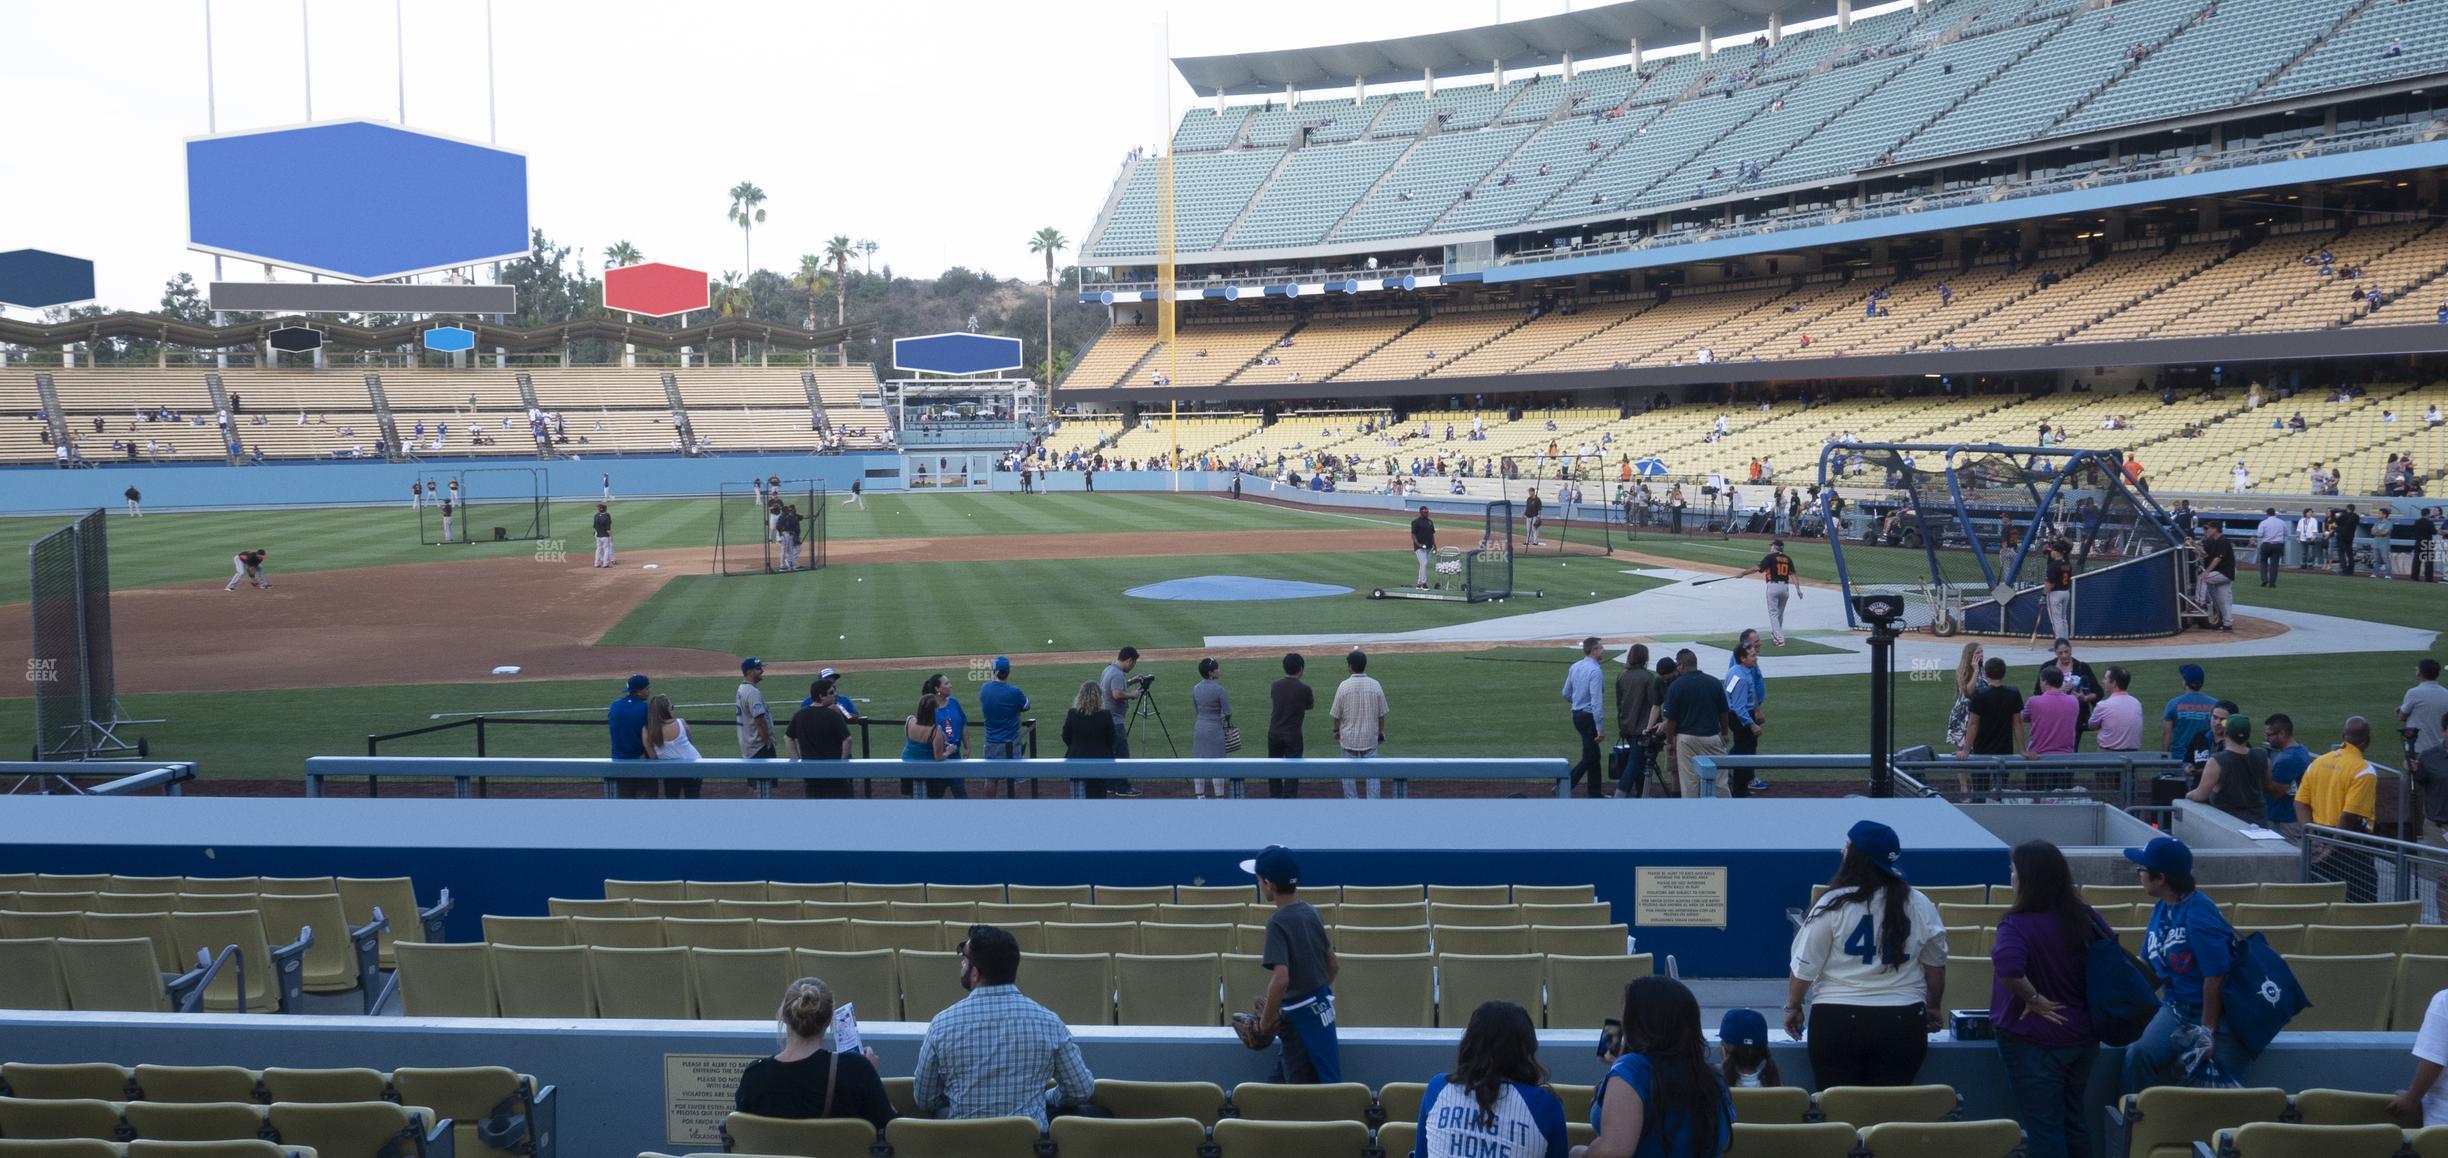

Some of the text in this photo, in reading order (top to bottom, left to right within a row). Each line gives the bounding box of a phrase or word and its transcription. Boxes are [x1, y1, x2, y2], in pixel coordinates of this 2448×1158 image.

[1776, 564, 1789, 576] 10
[1510, 1120, 1529, 1146] IT
[1450, 1134, 1511, 1158] HOME
